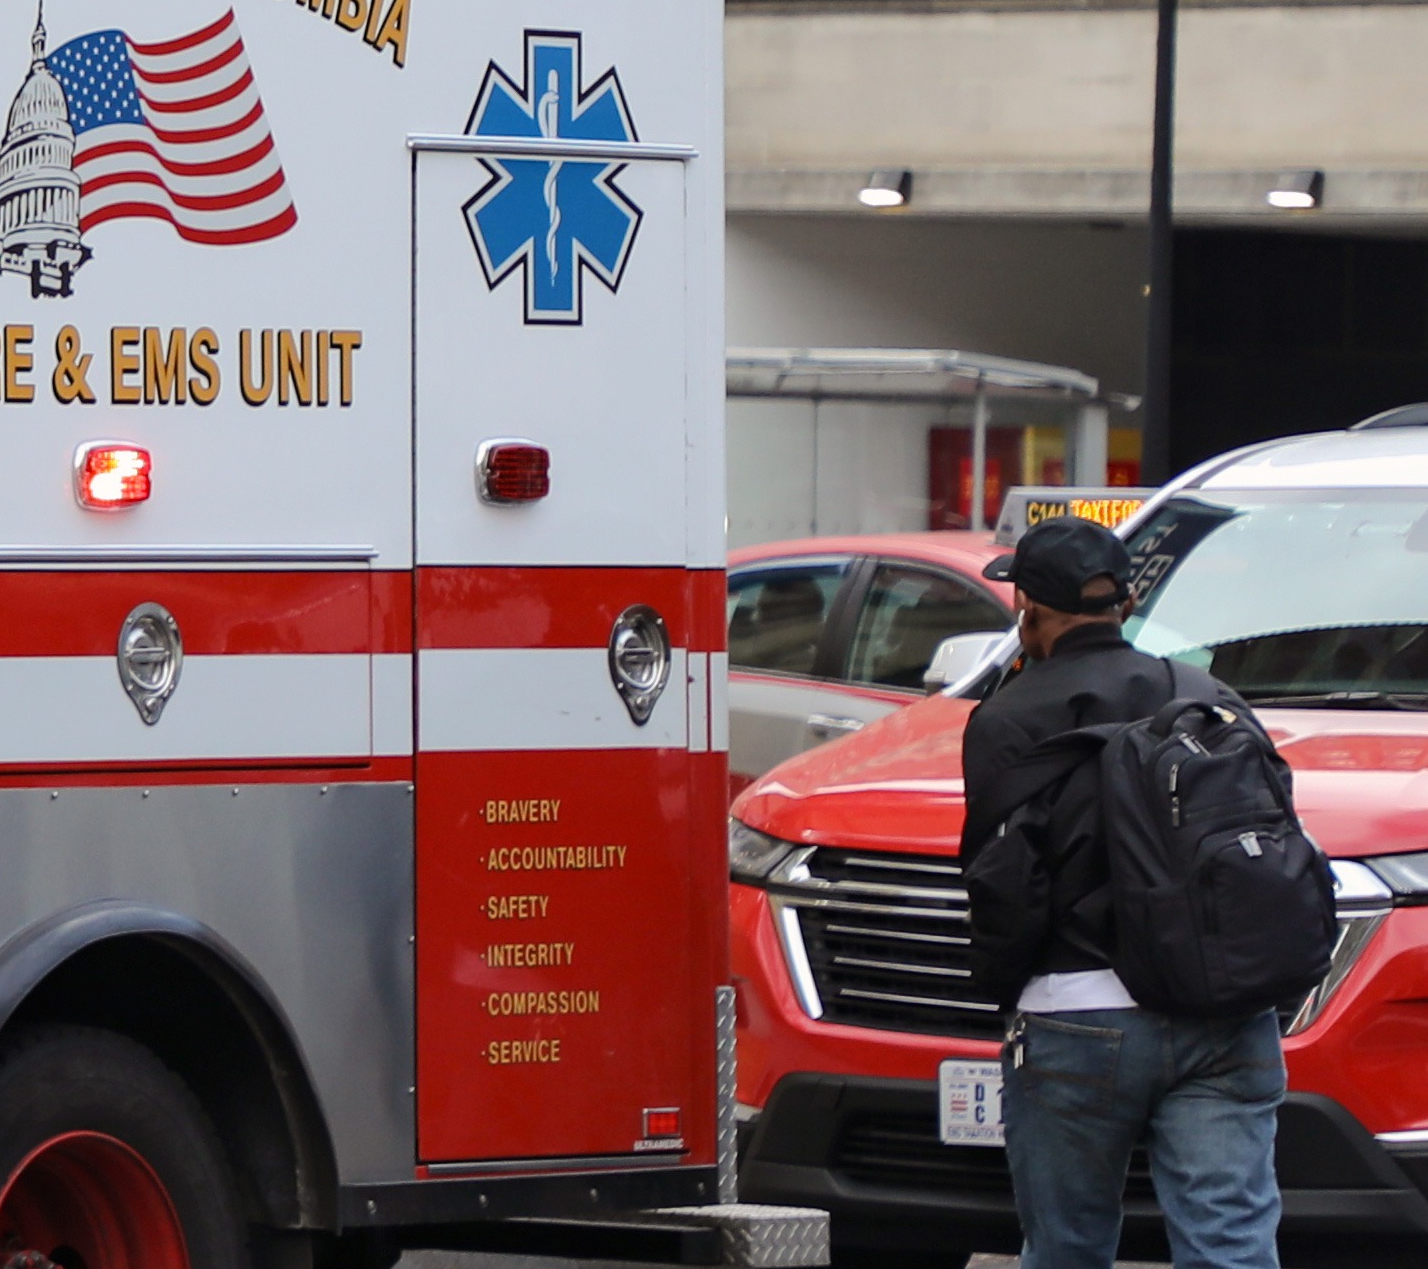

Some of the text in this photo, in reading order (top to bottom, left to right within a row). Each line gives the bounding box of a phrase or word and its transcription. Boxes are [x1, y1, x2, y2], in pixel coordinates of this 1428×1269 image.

[52, 325, 96, 406] &
[109, 327, 221, 407] EMS
[239, 329, 363, 408] UNIT
[485, 799, 561, 824] BRAVERY
[487, 845, 627, 872] ACCOUNTABILITY
[487, 895, 549, 920] SAFETY
[487, 943, 575, 968] INTEGRITY
[488, 991, 600, 1016] COMPASSION
[488, 1039, 561, 1065] SERVICE
